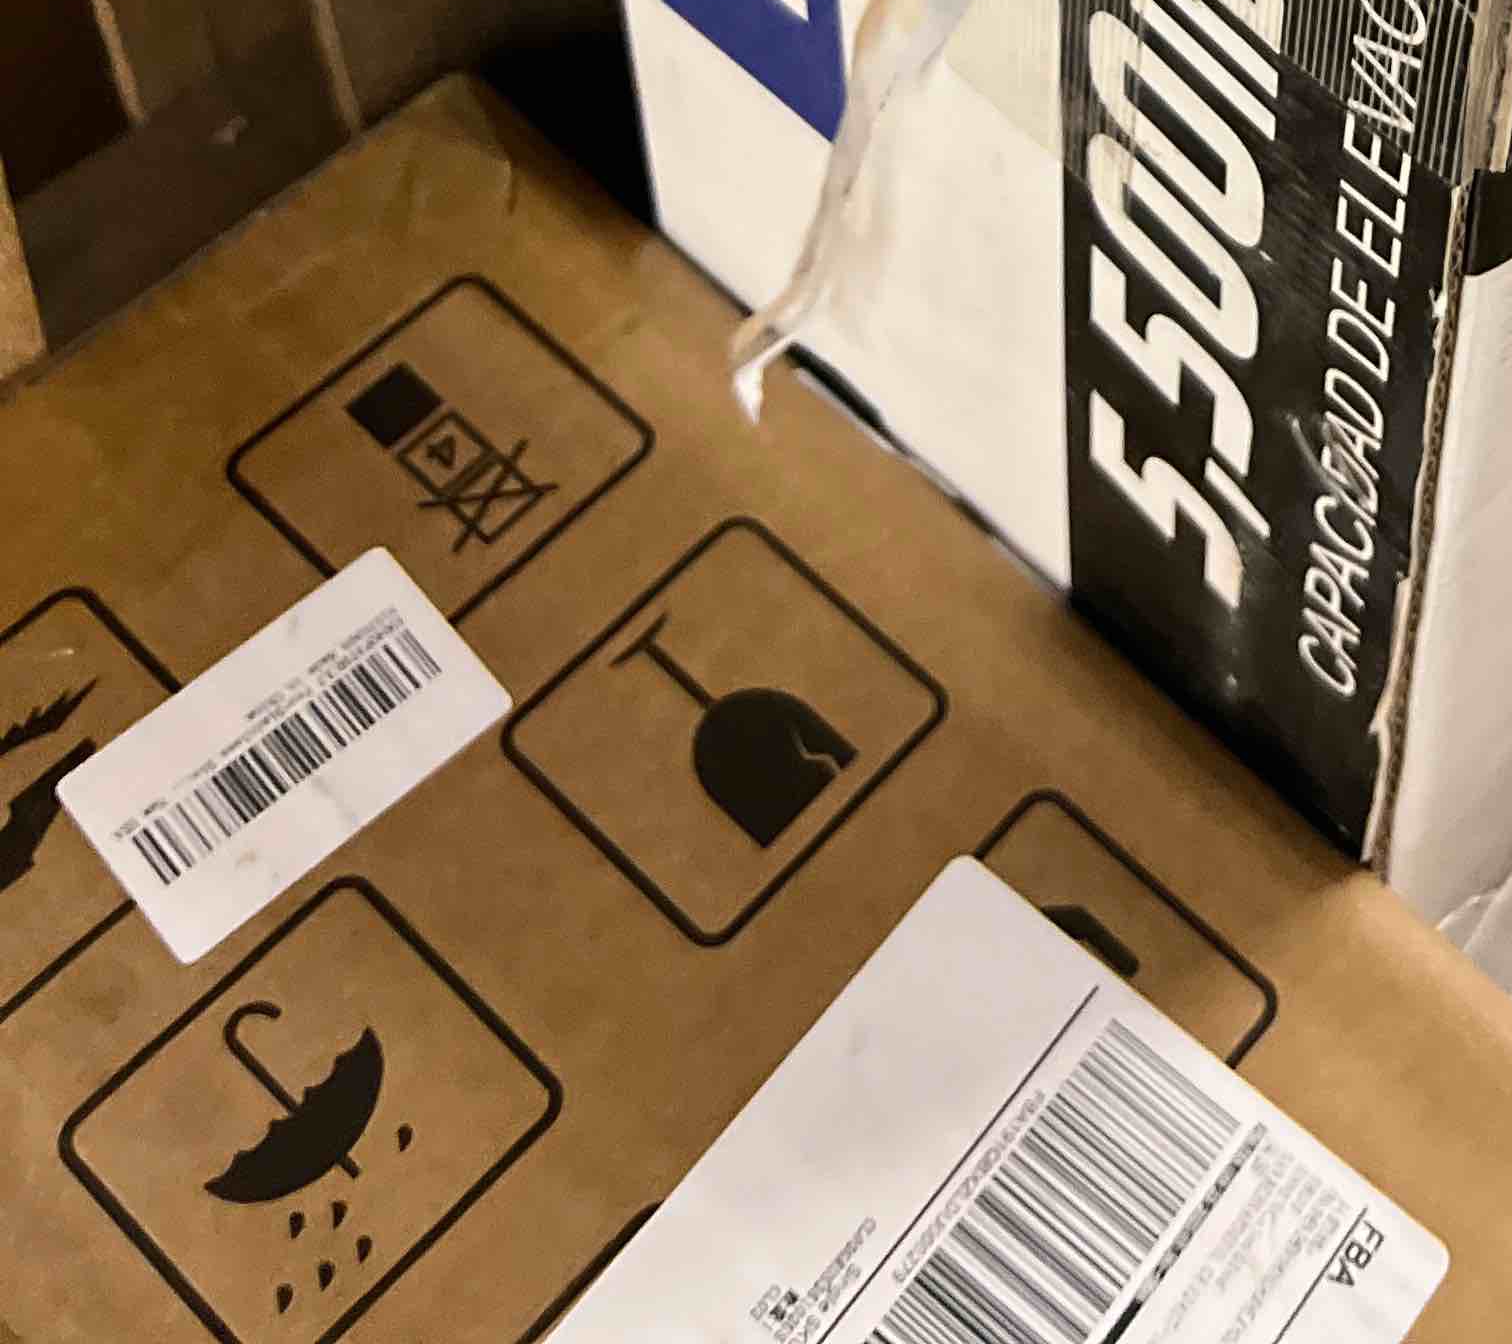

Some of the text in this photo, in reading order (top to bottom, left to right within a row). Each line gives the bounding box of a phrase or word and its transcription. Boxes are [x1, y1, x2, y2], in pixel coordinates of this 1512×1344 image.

[1326, 257, 1397, 383] DE
[1299, 366, 1385, 697] CAPACIDAD
[1327, 1219, 1386, 1287] FBA
